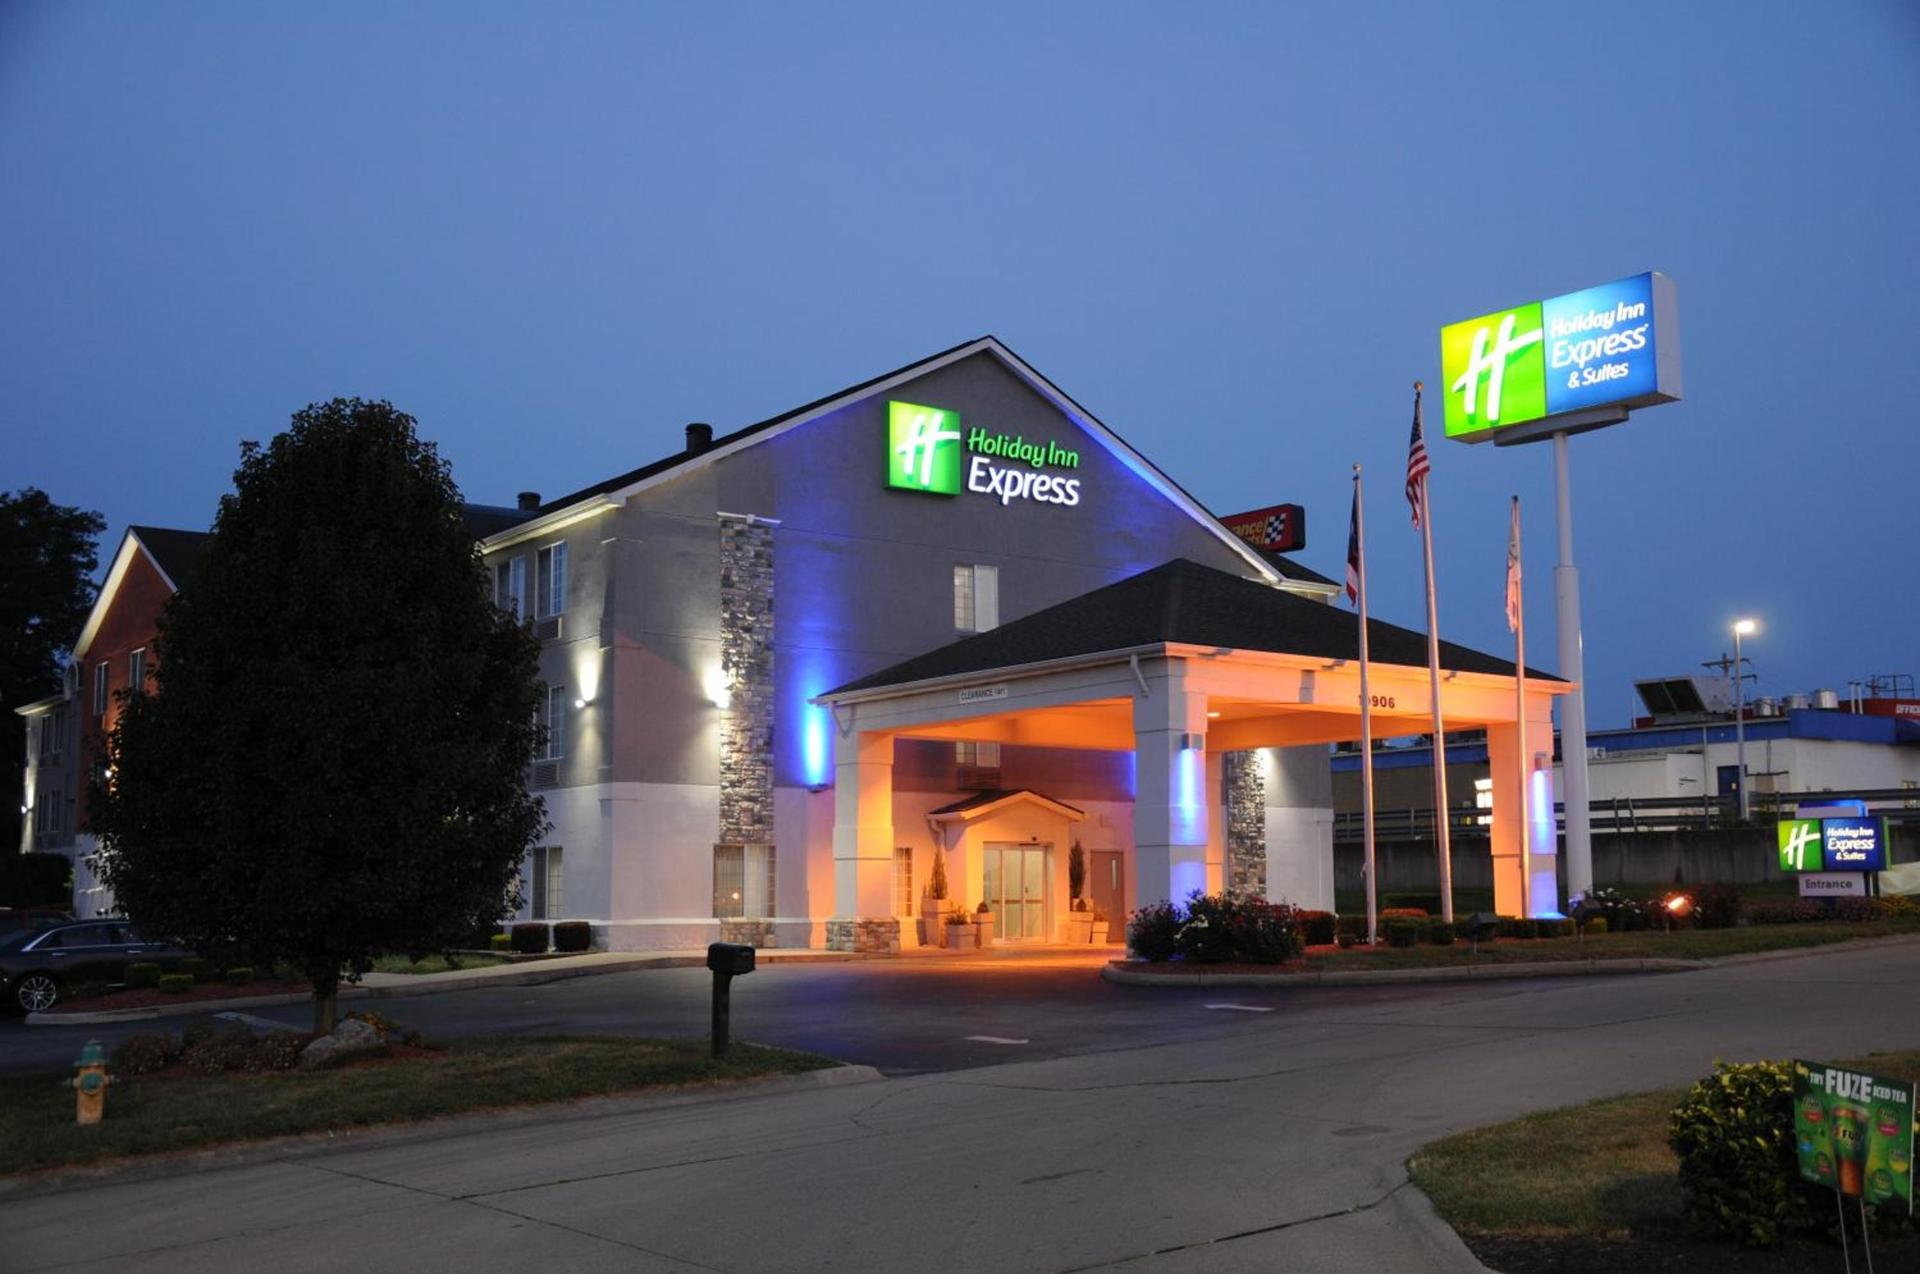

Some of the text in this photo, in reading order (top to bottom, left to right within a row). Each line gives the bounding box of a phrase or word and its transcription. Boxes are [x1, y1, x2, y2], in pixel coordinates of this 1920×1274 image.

[1551, 302, 1645, 338] Holiday Inn
[1552, 327, 1646, 368] Express
[1568, 363, 1629, 388] & Suites
[968, 427, 1078, 468] Holiday Inn
[968, 456, 1080, 505] Express
[1231, 520, 1264, 537] ance
[1827, 827, 1874, 838] Holiday Inn
[1828, 838, 1874, 851] Express
[1805, 880, 1853, 889] Entrance
[1825, 1069, 1872, 1103] FUZE
[1873, 1085, 1891, 1099] ICED
[1892, 1089, 1906, 1103] TEA
